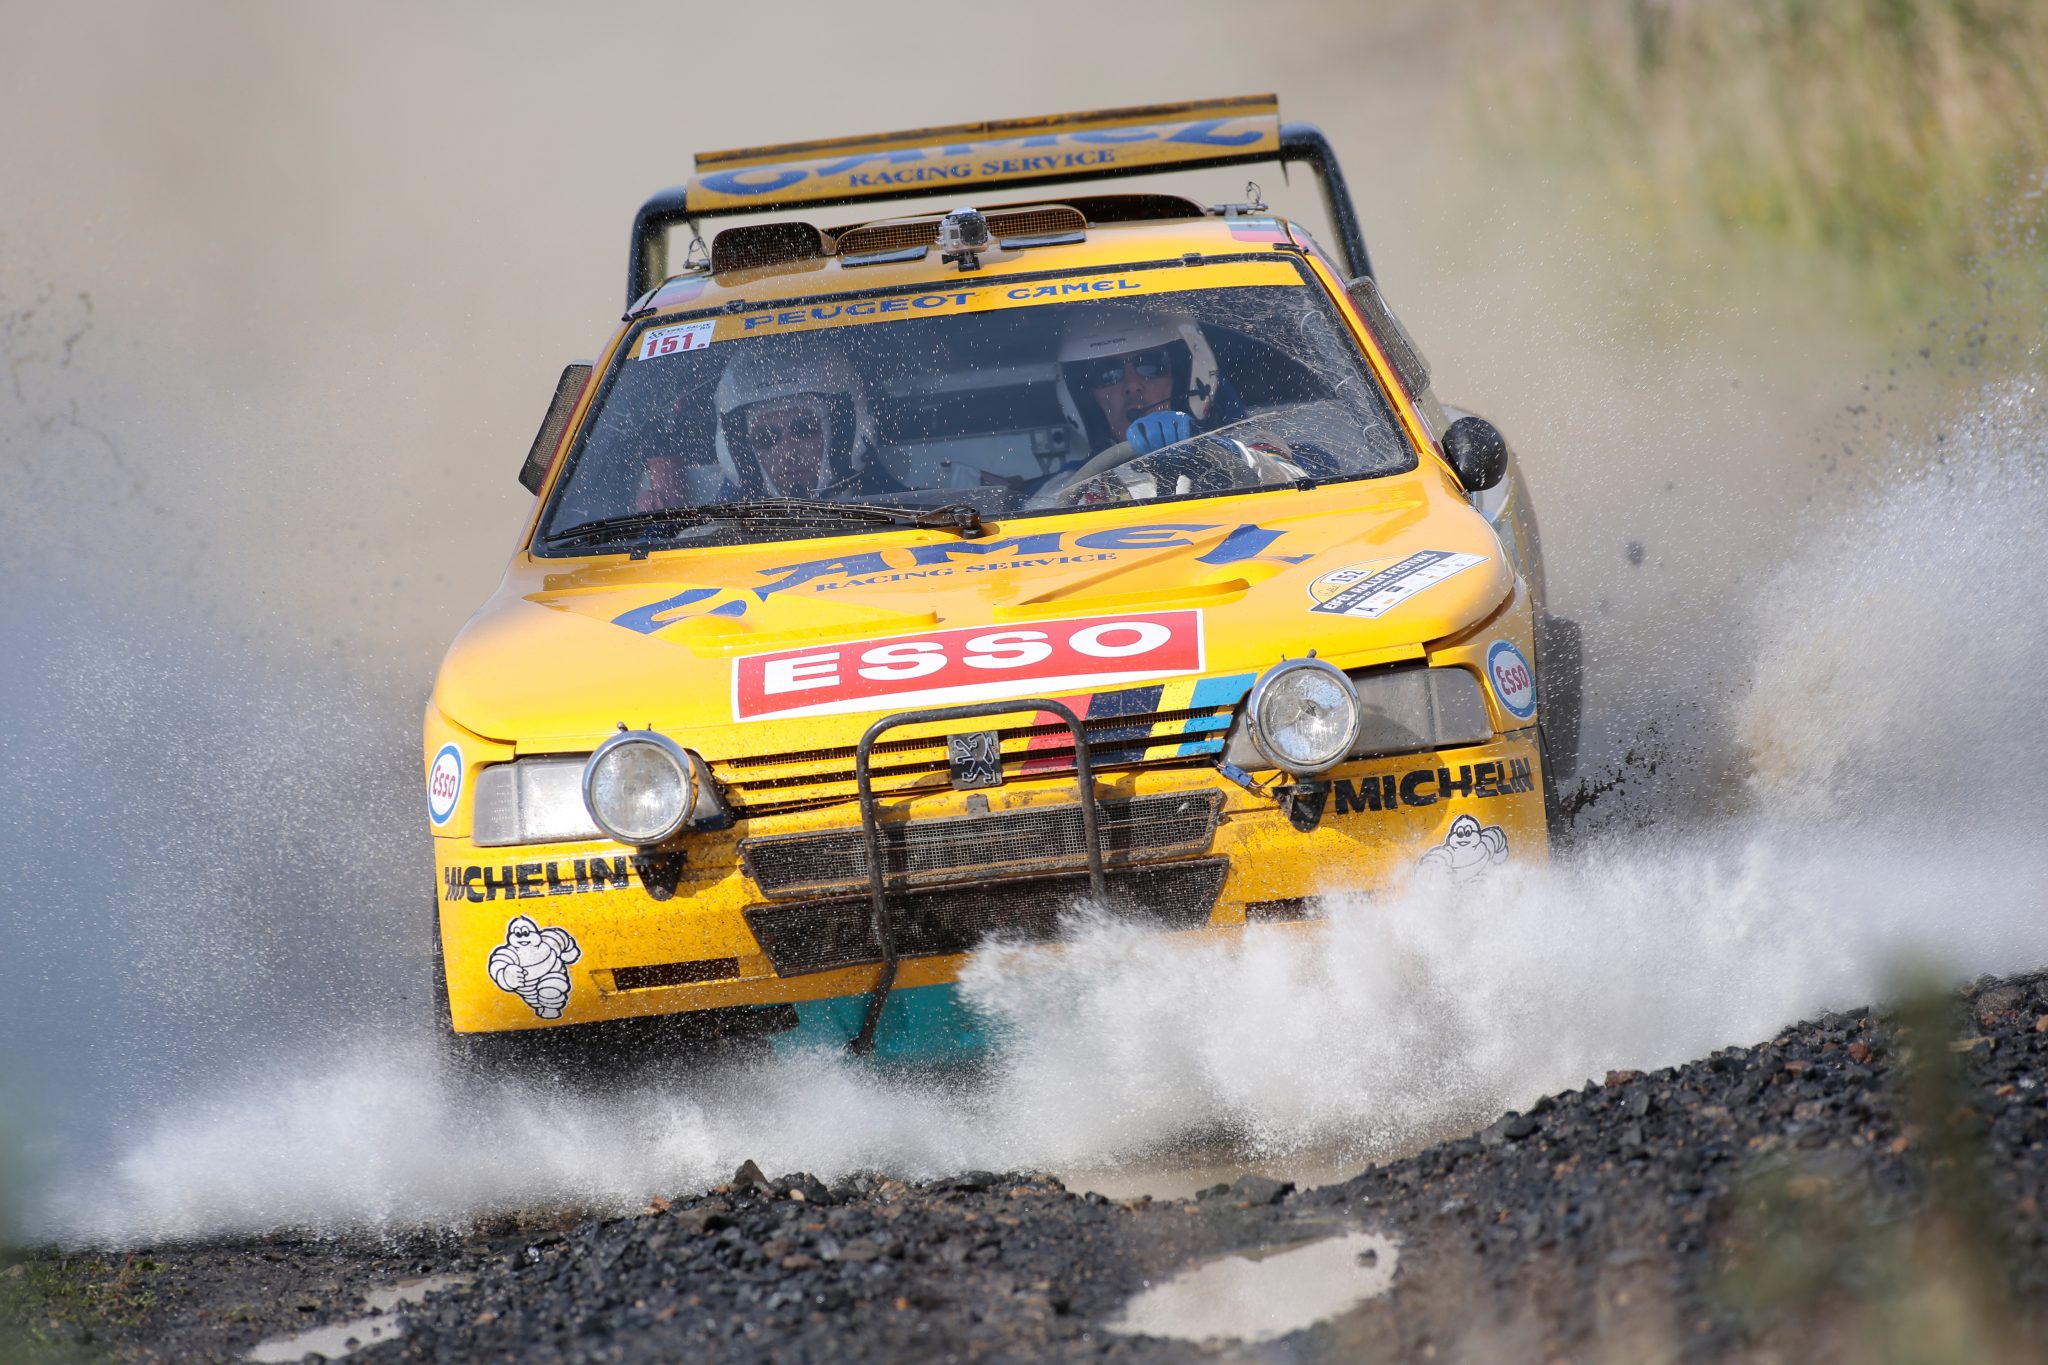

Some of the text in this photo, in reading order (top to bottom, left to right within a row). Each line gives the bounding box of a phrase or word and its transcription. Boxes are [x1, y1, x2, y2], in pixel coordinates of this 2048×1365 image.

[849, 148, 1116, 188] RACING SERVICE
[742, 279, 1142, 330] PEUGEOT CAMEL
[610, 523, 1316, 635] CAMEL
[816, 552, 1117, 592] RACING SERVICE
[763, 621, 1172, 696] ESSO
[1333, 756, 1535, 815] MICHELIN
